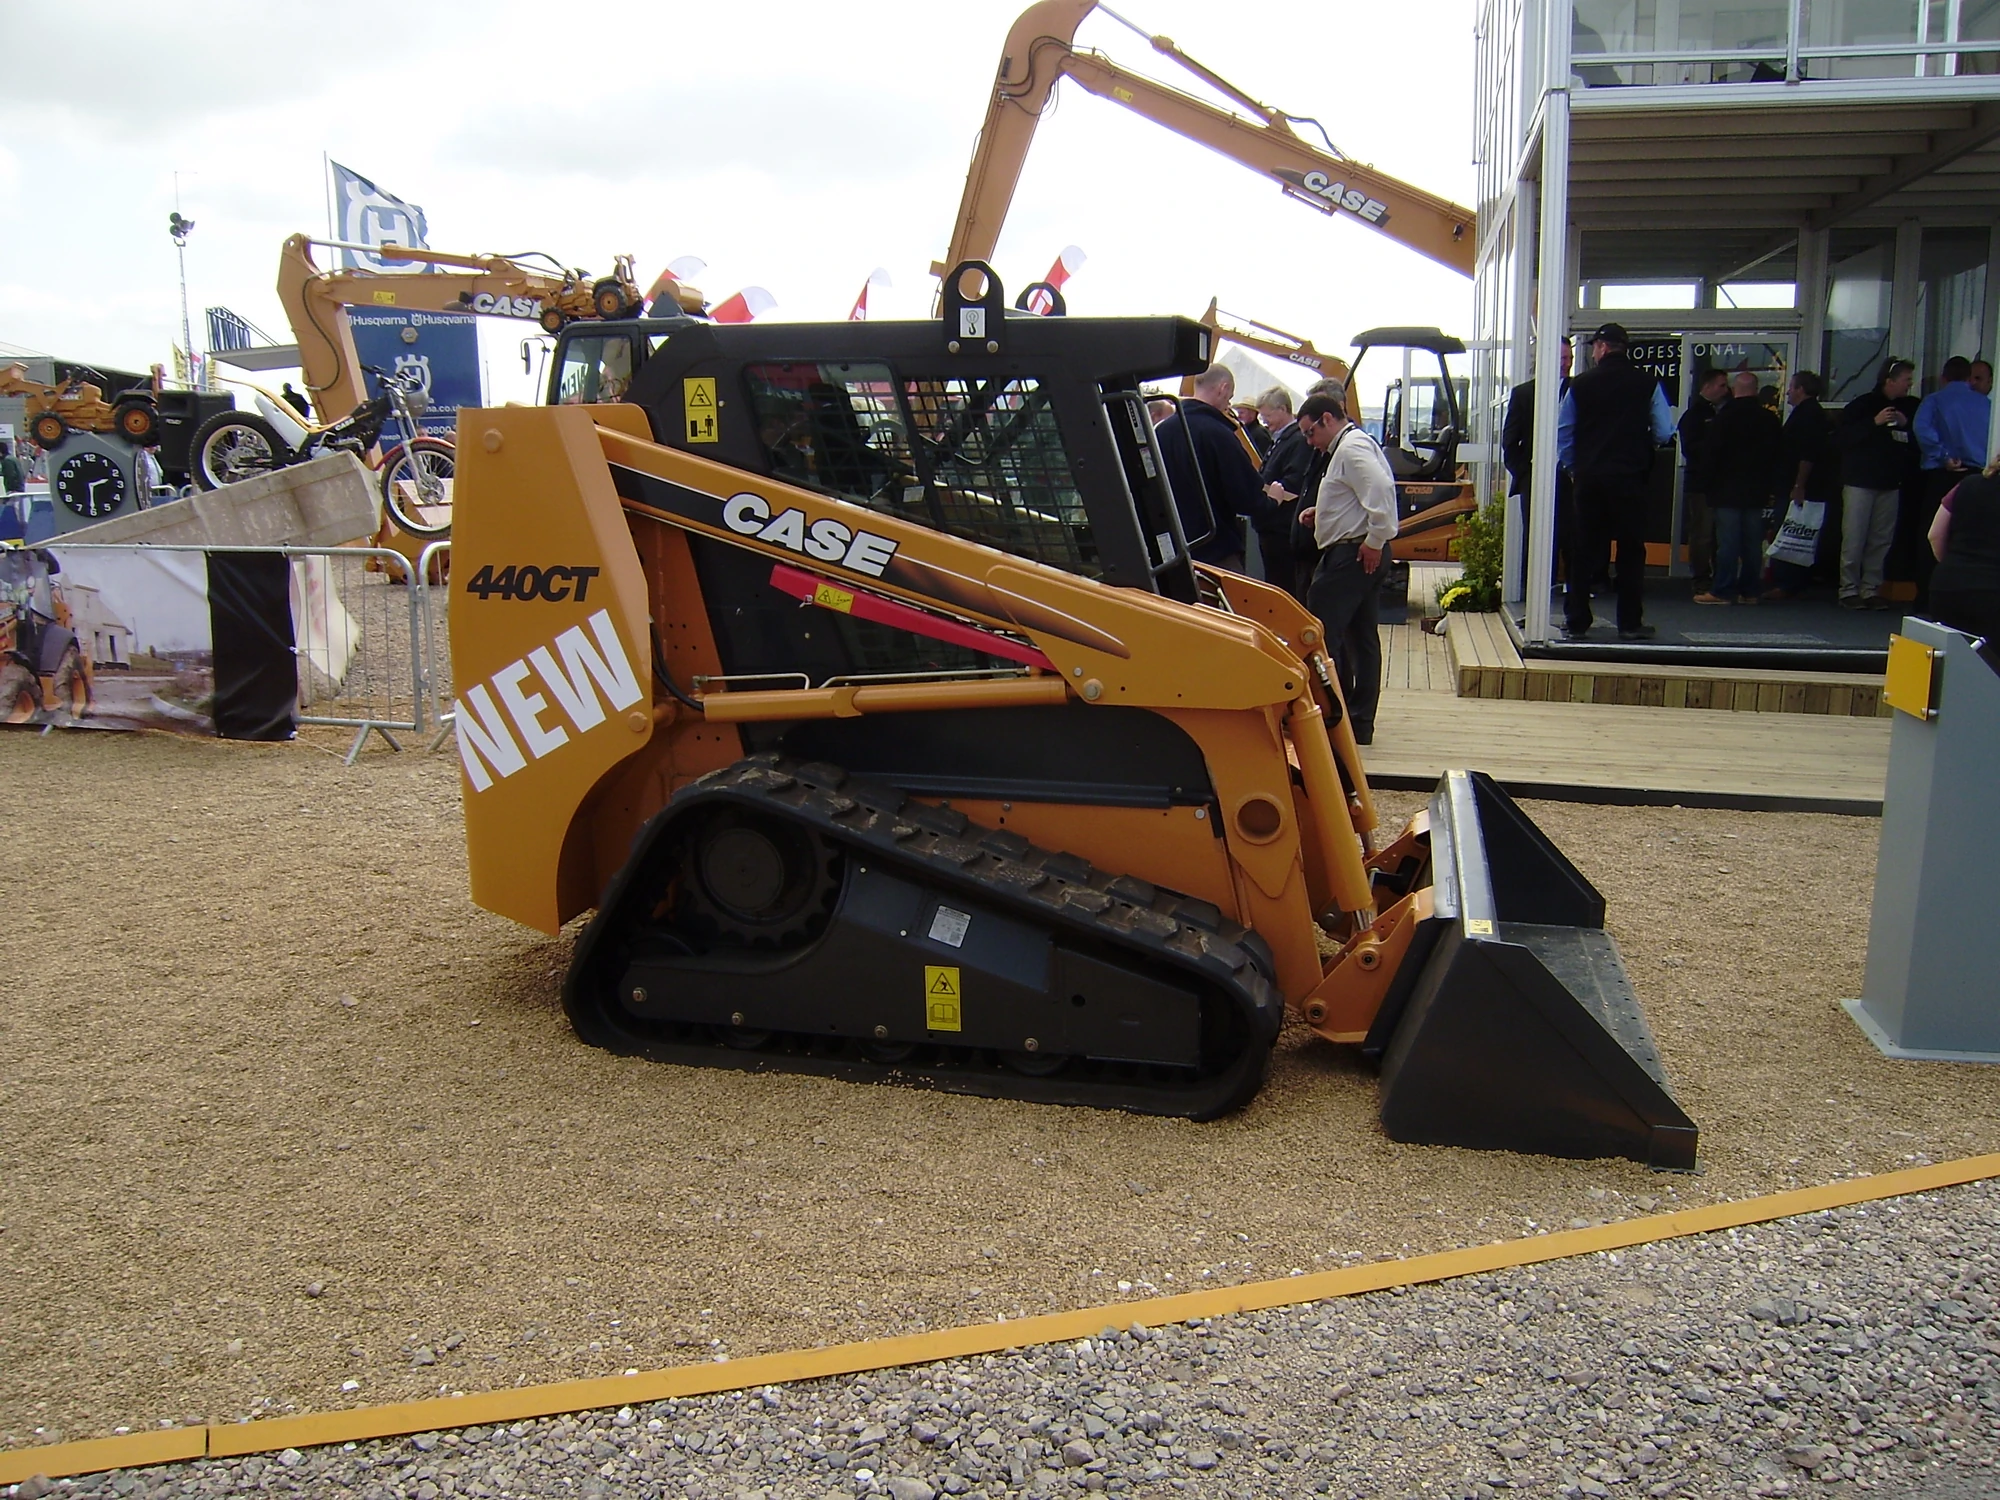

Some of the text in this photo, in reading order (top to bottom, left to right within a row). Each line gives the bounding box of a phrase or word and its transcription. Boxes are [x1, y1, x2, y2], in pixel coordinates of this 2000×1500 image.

[1303, 171, 1387, 222] CASE
[353, 315, 475, 327] Husqvarna Husqvarna
[1289, 353, 1321, 368] CASE
[84, 454, 96, 462] 12
[61, 470, 74, 478] 10
[723, 492, 899, 577] CASE
[467, 565, 600, 602] 440CT
[455, 608, 643, 793] NEW
